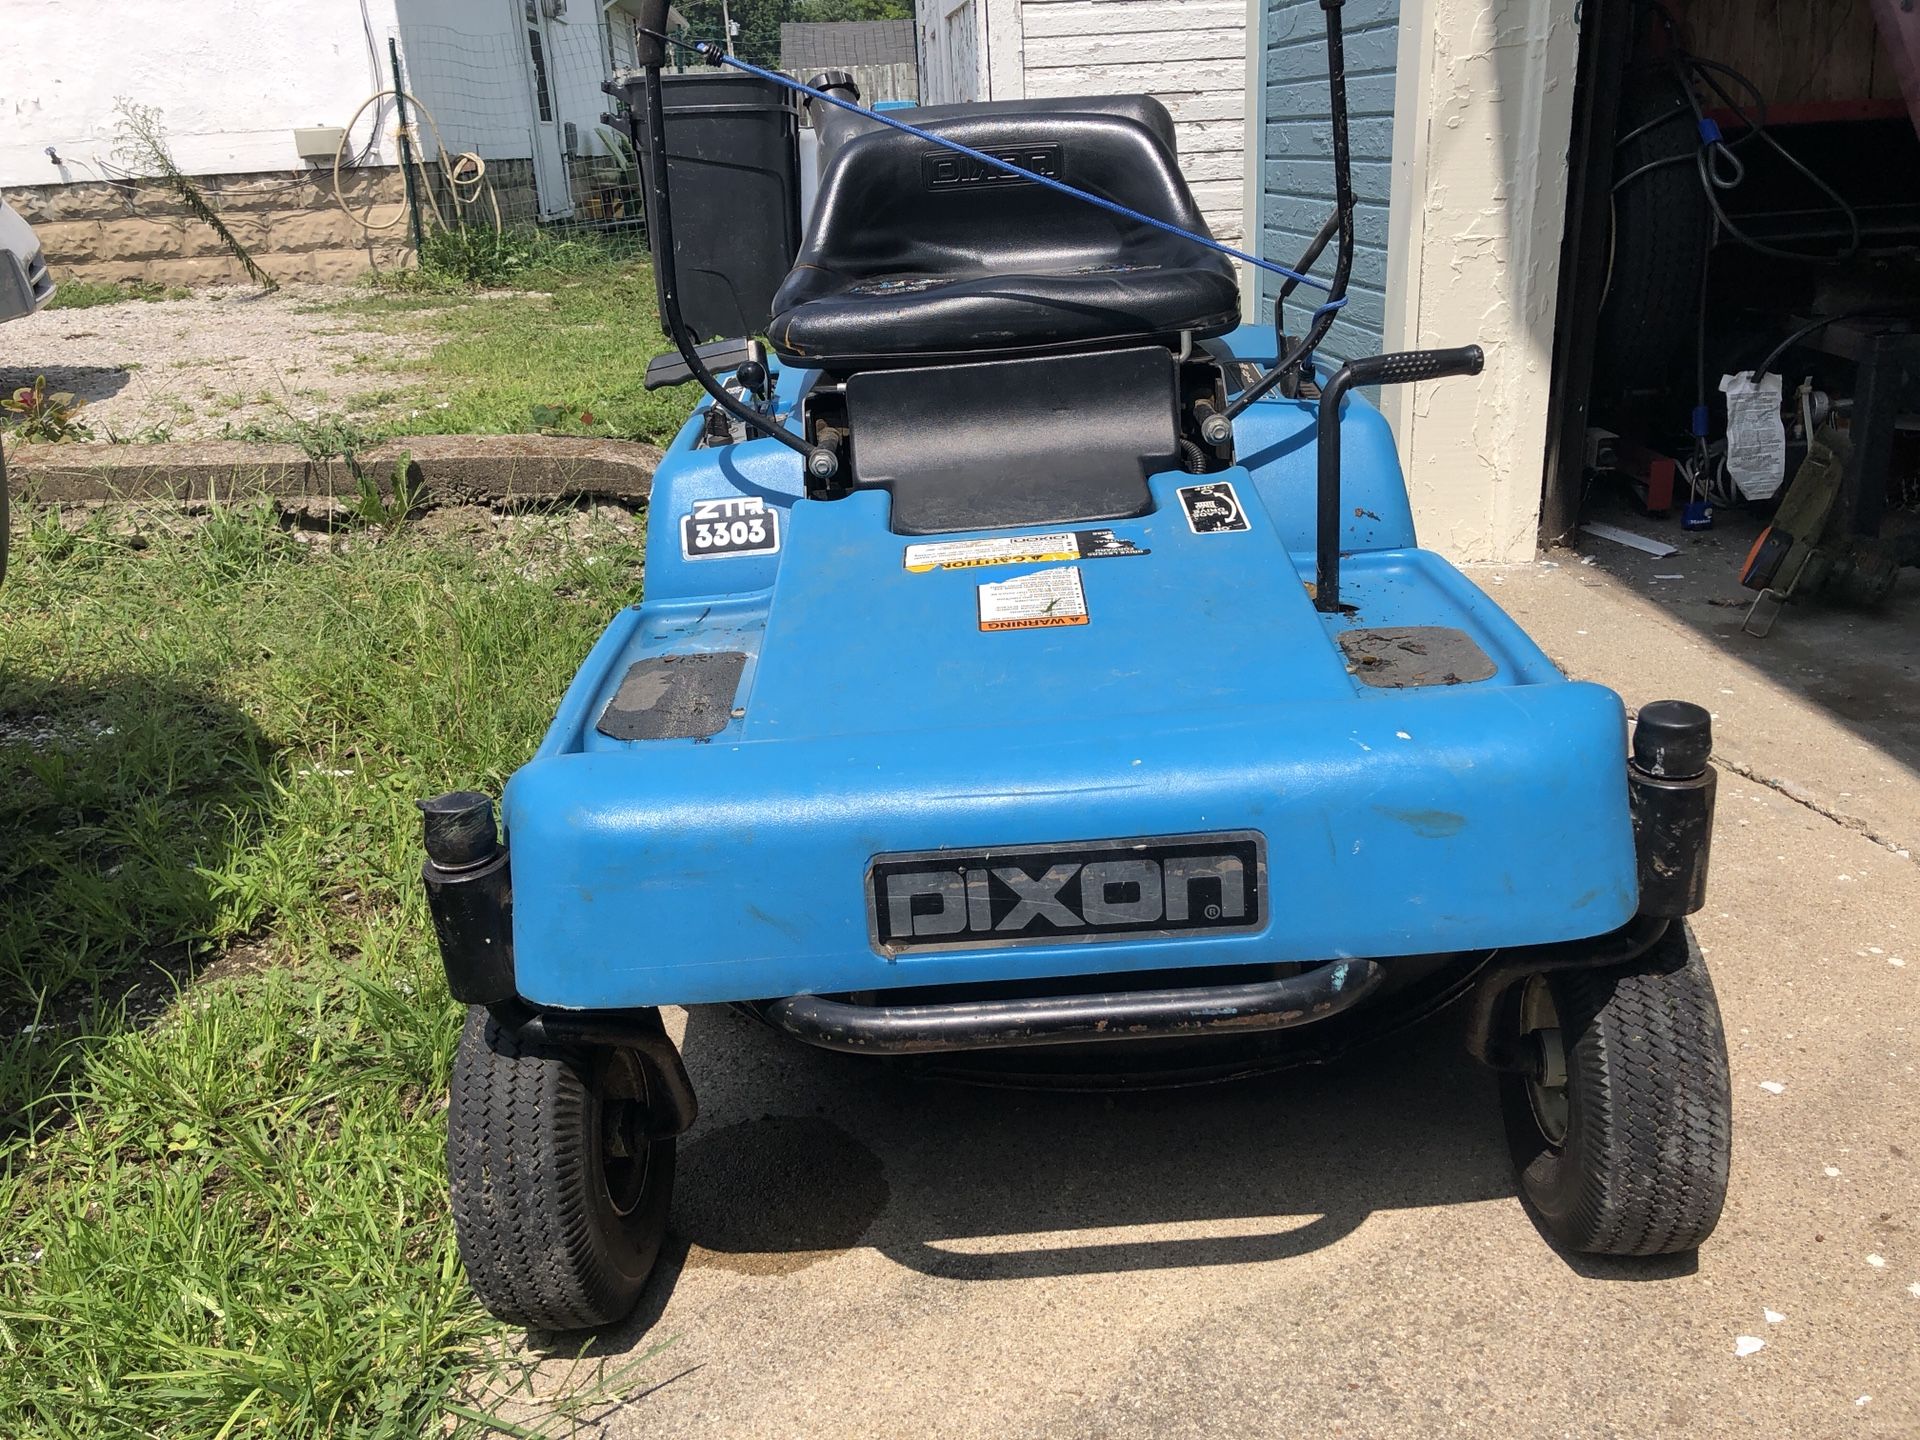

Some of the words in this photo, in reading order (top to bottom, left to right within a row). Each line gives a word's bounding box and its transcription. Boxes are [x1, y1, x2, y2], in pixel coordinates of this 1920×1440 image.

[694, 499, 764, 519] ZTR
[695, 519, 766, 548] 3303
[941, 556, 1025, 568] CAUTION
[988, 618, 1066, 629] WARNING
